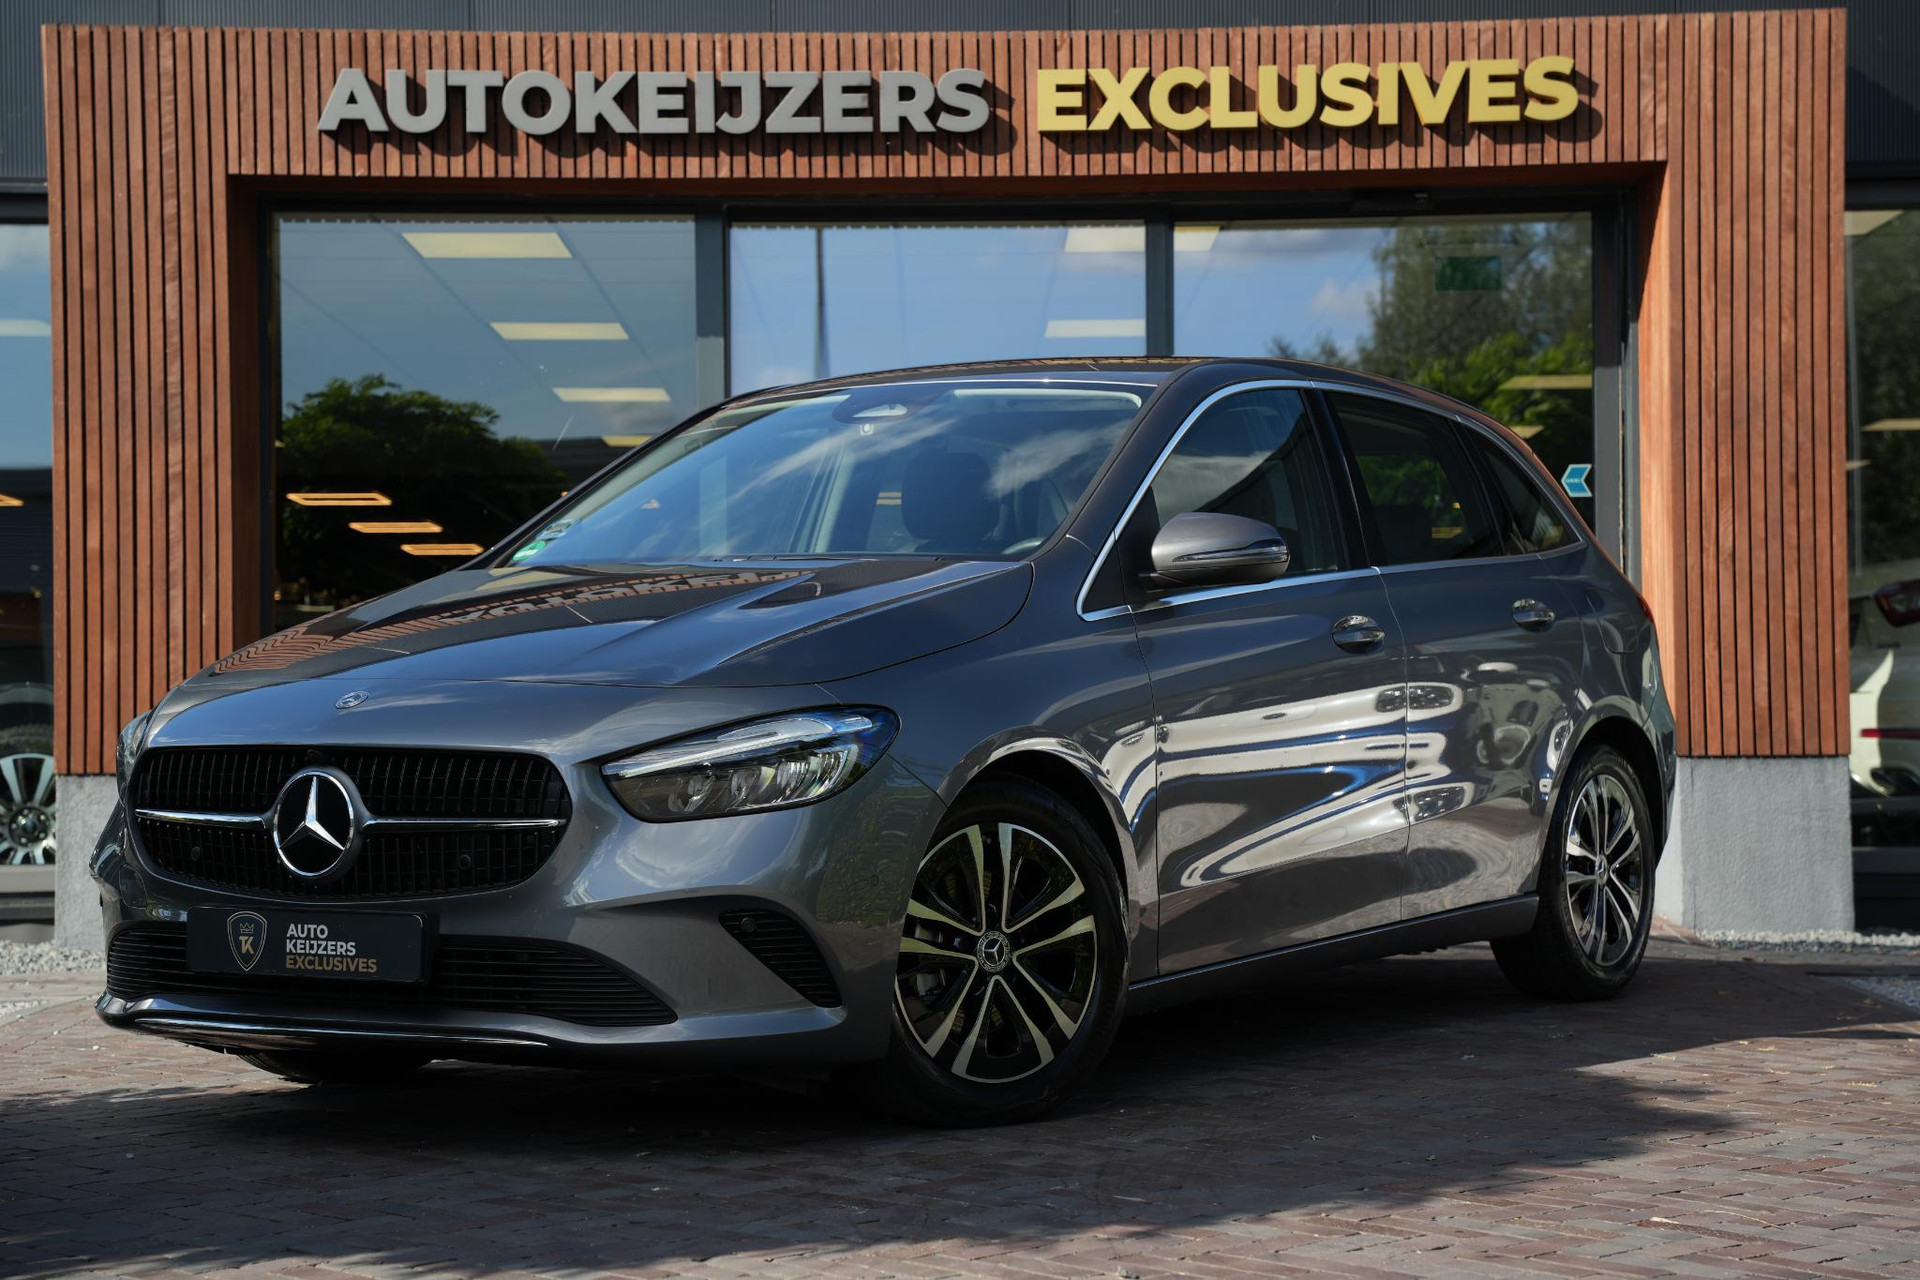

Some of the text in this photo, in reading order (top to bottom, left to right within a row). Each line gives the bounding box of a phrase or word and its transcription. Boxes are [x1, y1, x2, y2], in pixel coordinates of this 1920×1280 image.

[317, 55, 1579, 135] AUTOKEIJZERS EXCLUSIVES
[286, 923, 329, 939] AUTO
[286, 939, 356, 956] KEIJZERS
[285, 954, 378, 973] EXCLUSIVES
